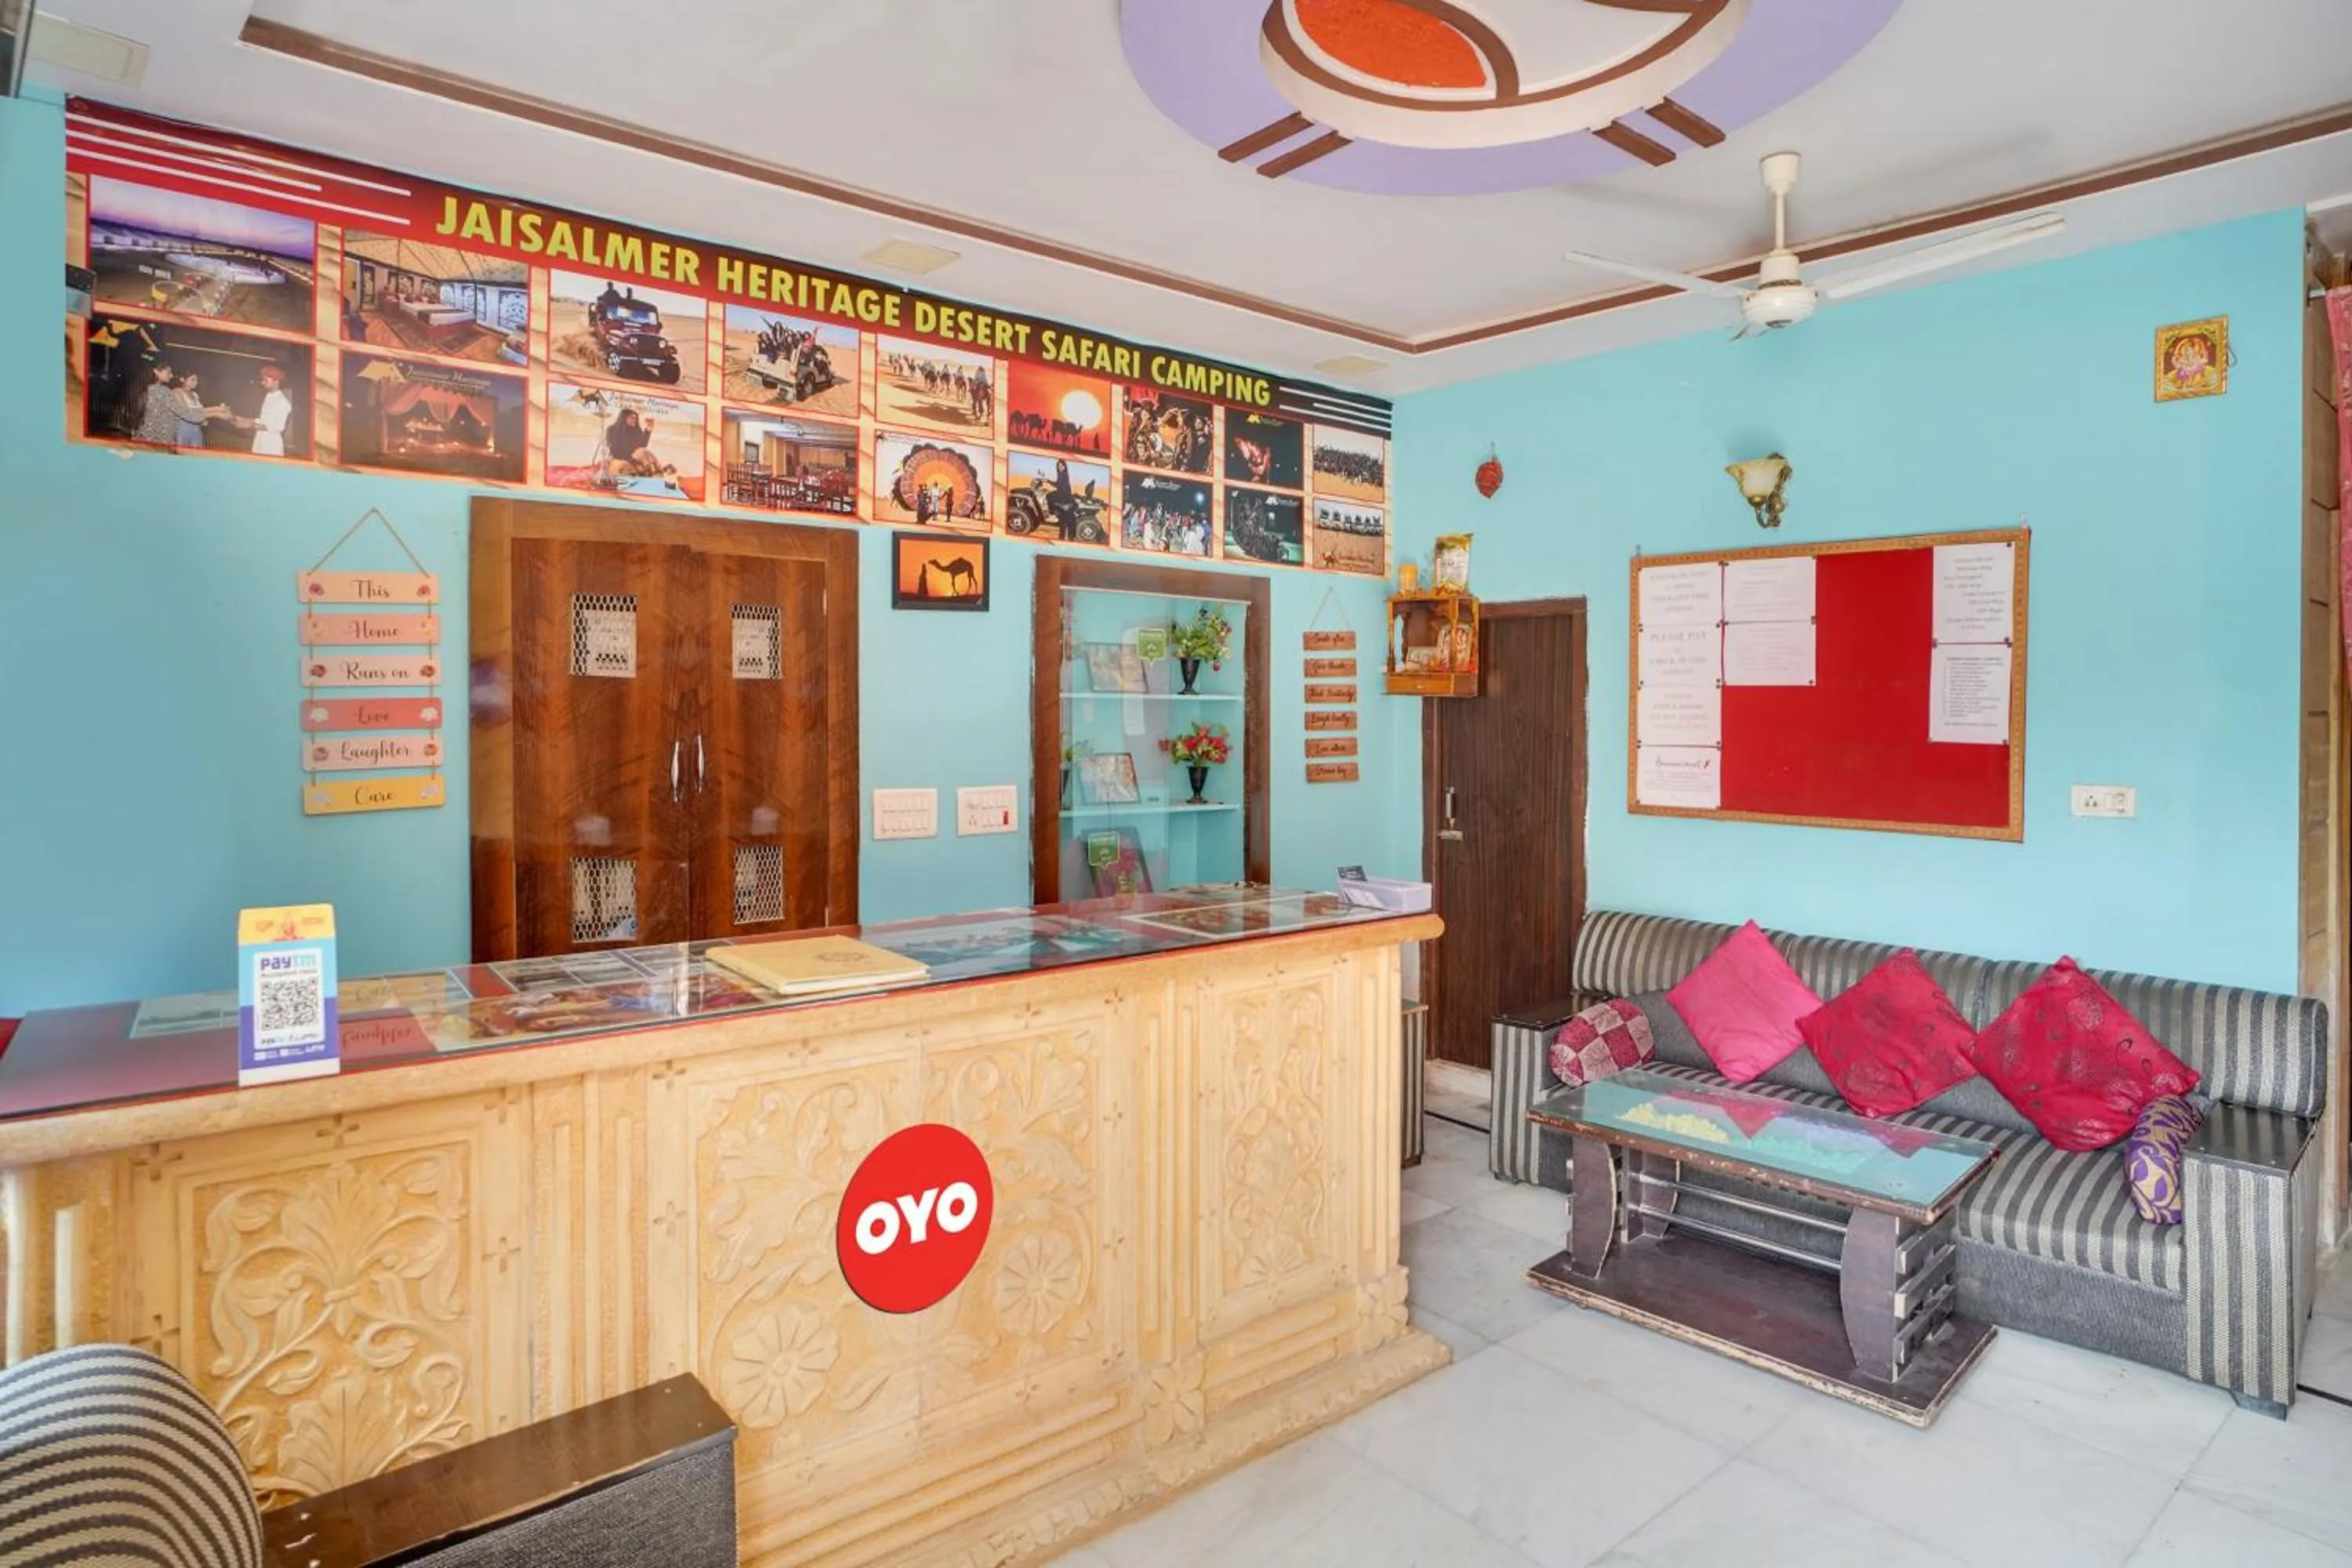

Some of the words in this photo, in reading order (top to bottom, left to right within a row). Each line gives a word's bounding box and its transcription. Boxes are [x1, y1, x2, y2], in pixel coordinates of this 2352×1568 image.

[435, 196, 699, 285] JAISALMER
[717, 256, 900, 326] HERITAGE
[914, 301, 1031, 354] DESERT
[1041, 329, 1142, 379] SAFARI
[1150, 355, 1272, 406] CAMPING
[350, 579, 390, 599] This
[343, 619, 401, 639] Home
[340, 661, 387, 681] Runs
[391, 667, 410, 680] on
[355, 704, 390, 725] Love
[341, 740, 412, 764] Laughter
[354, 785, 395, 804] Care
[855, 1181, 978, 1254] OYO
